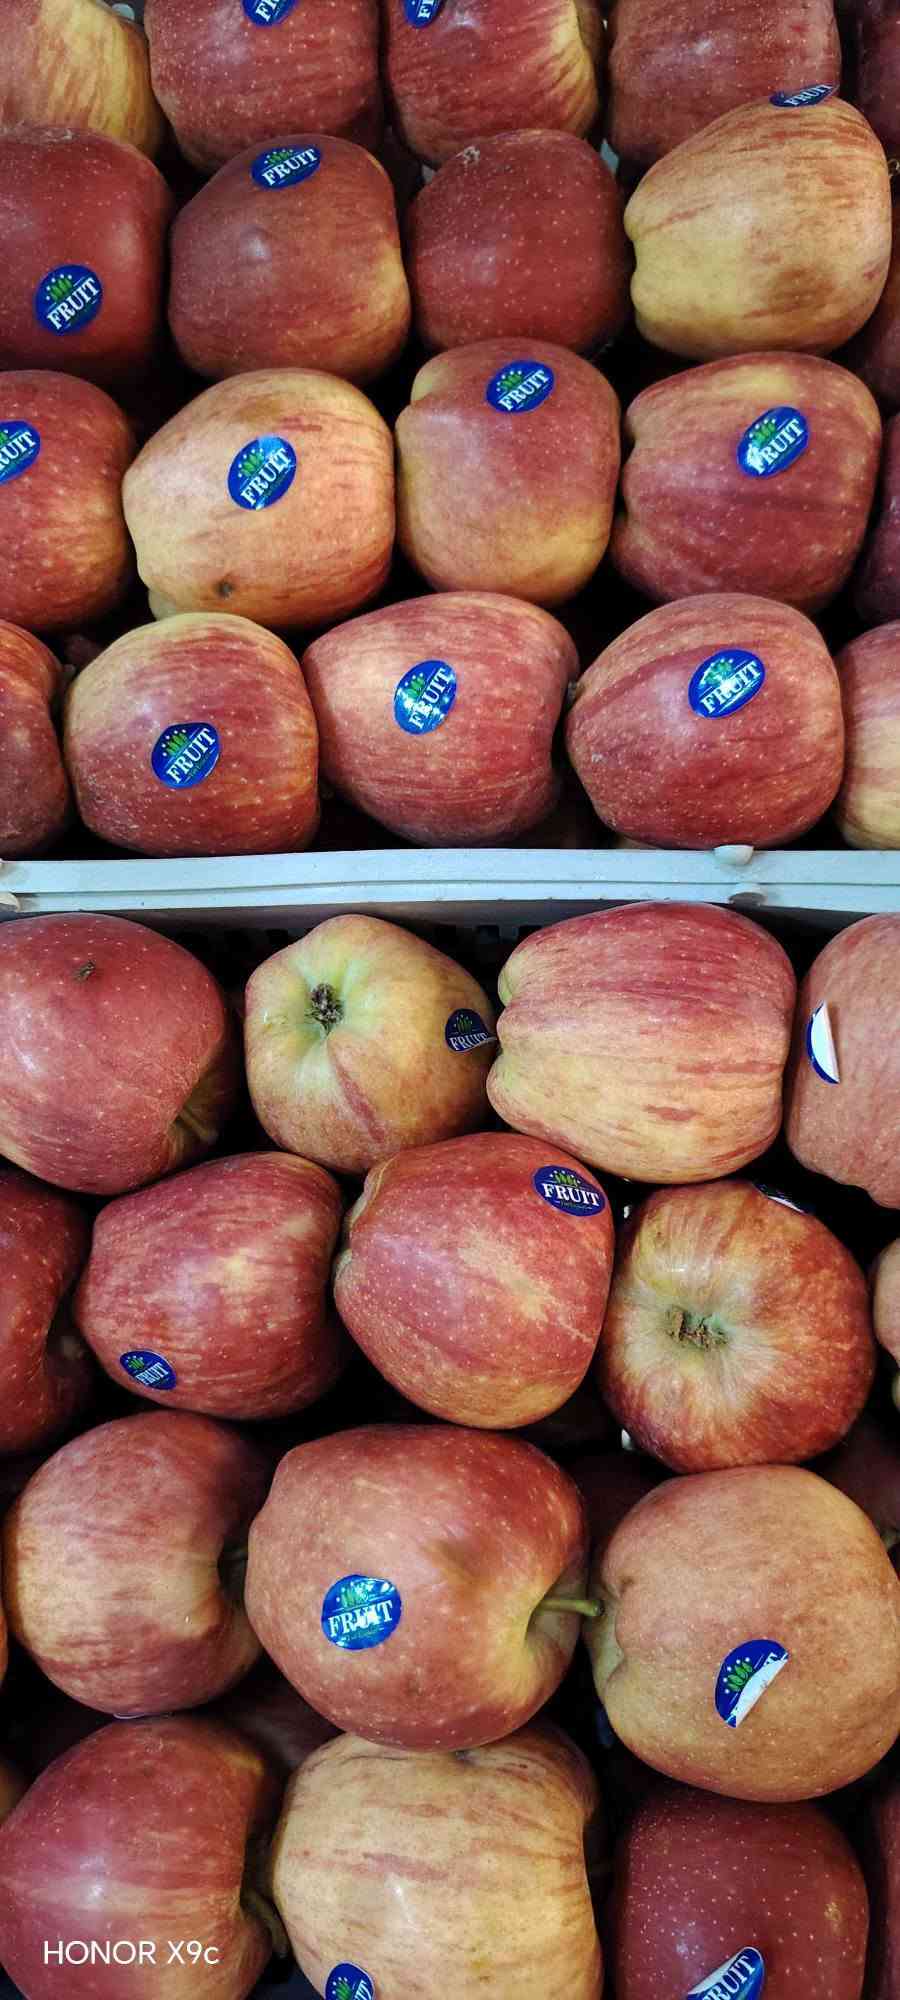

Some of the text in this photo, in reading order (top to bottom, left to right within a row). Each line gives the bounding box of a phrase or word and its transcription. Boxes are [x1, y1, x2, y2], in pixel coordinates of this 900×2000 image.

[784, 84, 833, 106] FRUIT
[262, 148, 318, 186] FRUIT
[47, 277, 99, 330] FRUIT
[498, 369, 549, 411] FRUIT
[0, 431, 36, 471] RUIT
[748, 418, 804, 475] FRUIT
[241, 447, 292, 507] FRUIT
[408, 667, 451, 729] FRUIT
[700, 660, 761, 714] FRUIT
[166, 727, 216, 784] FRUIT
[449, 1032, 488, 1051] FRUIT
[541, 1182, 600, 1207] FRUIT
[135, 1362, 169, 1385] FRUIT
[327, 1599, 393, 1638] FRUIT
[702, 1955, 756, 2000] RUIT
